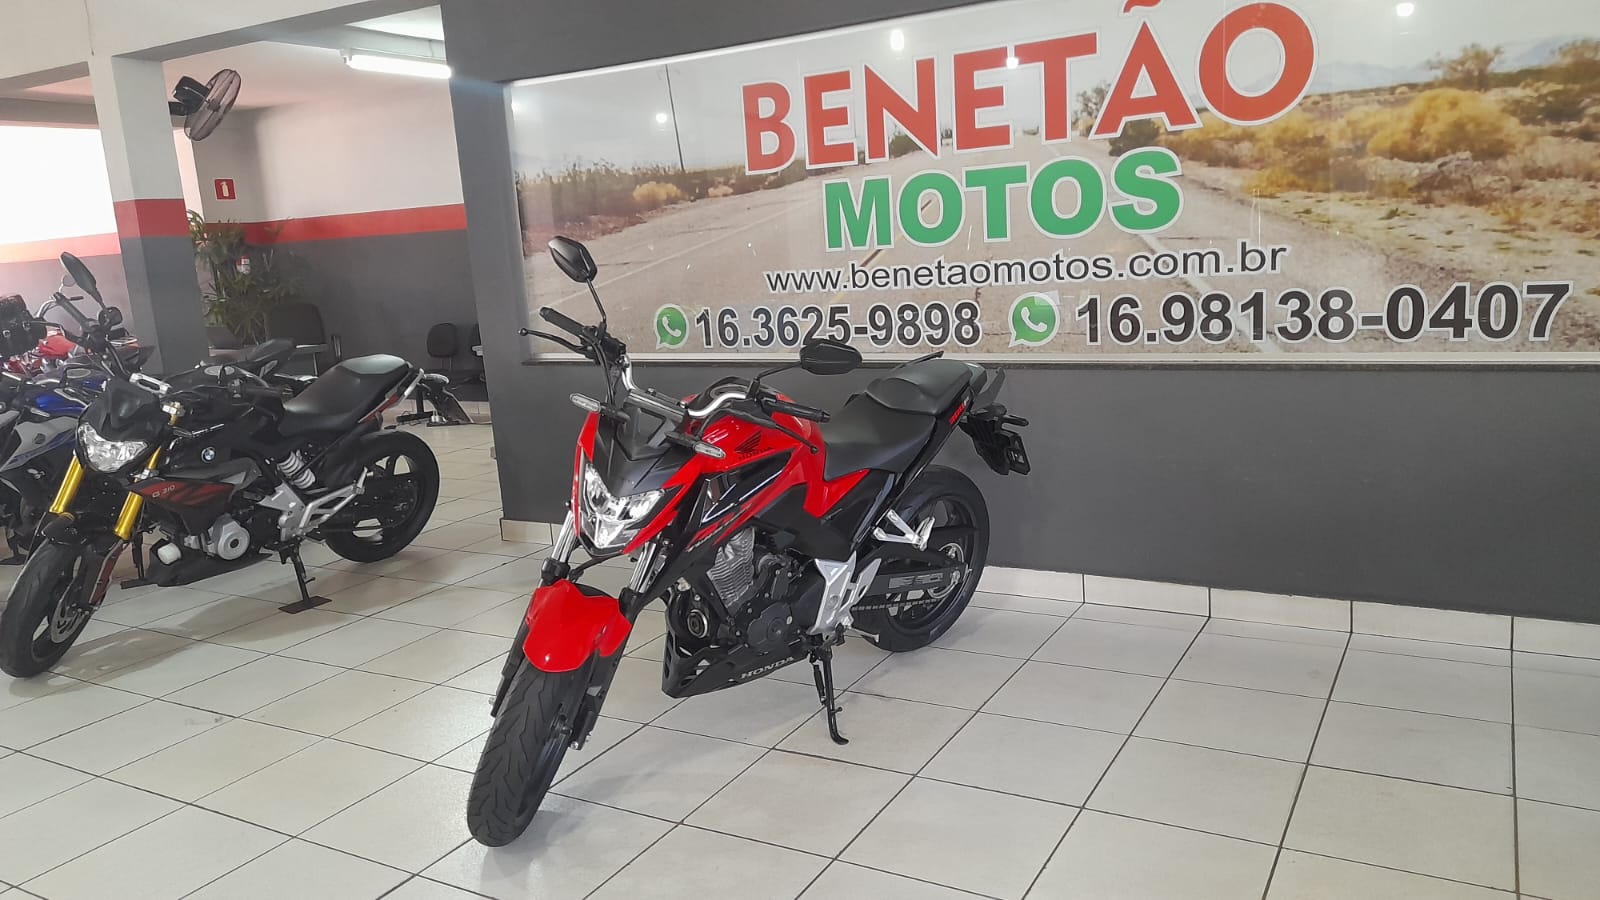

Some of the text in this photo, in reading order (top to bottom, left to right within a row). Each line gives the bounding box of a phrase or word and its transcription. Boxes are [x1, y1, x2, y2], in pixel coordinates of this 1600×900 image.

[742, 0, 1315, 176] BENETÃO
[824, 149, 1183, 252] MOTOS
[767, 240, 1287, 293] www.benetaomotos.com.br
[695, 302, 981, 348] 16.3625-9898
[1076, 282, 1572, 344] 16.98138-0407
[741, 656, 794, 679] HONDA
